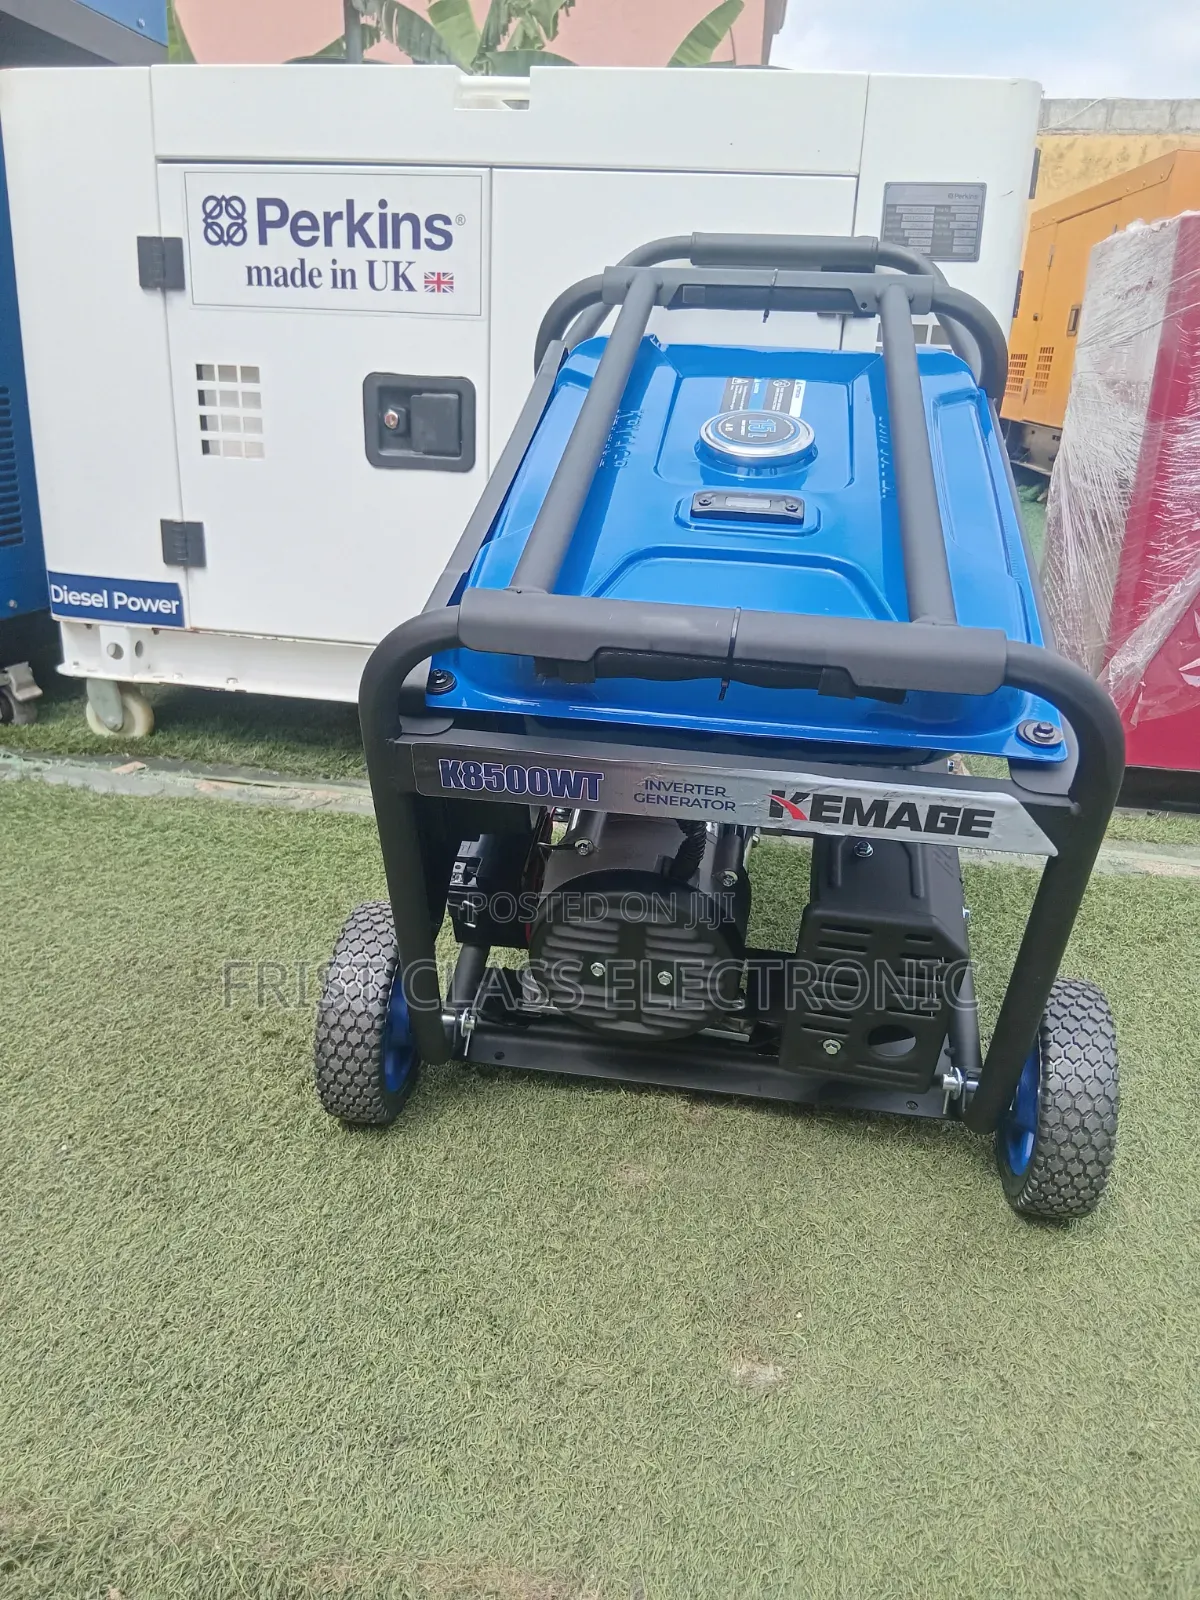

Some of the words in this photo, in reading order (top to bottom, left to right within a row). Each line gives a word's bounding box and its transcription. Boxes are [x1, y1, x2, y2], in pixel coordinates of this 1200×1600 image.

[245, 258, 323, 289] made
[330, 258, 359, 290] in
[366, 260, 418, 292] UK
[50, 584, 109, 608] Diesel
[113, 591, 181, 615] Power
[437, 758, 605, 802] K8500WT
[643, 778, 728, 798] INVERTER
[633, 791, 737, 812] GENERATOR
[767, 790, 996, 838] KEMAGE
